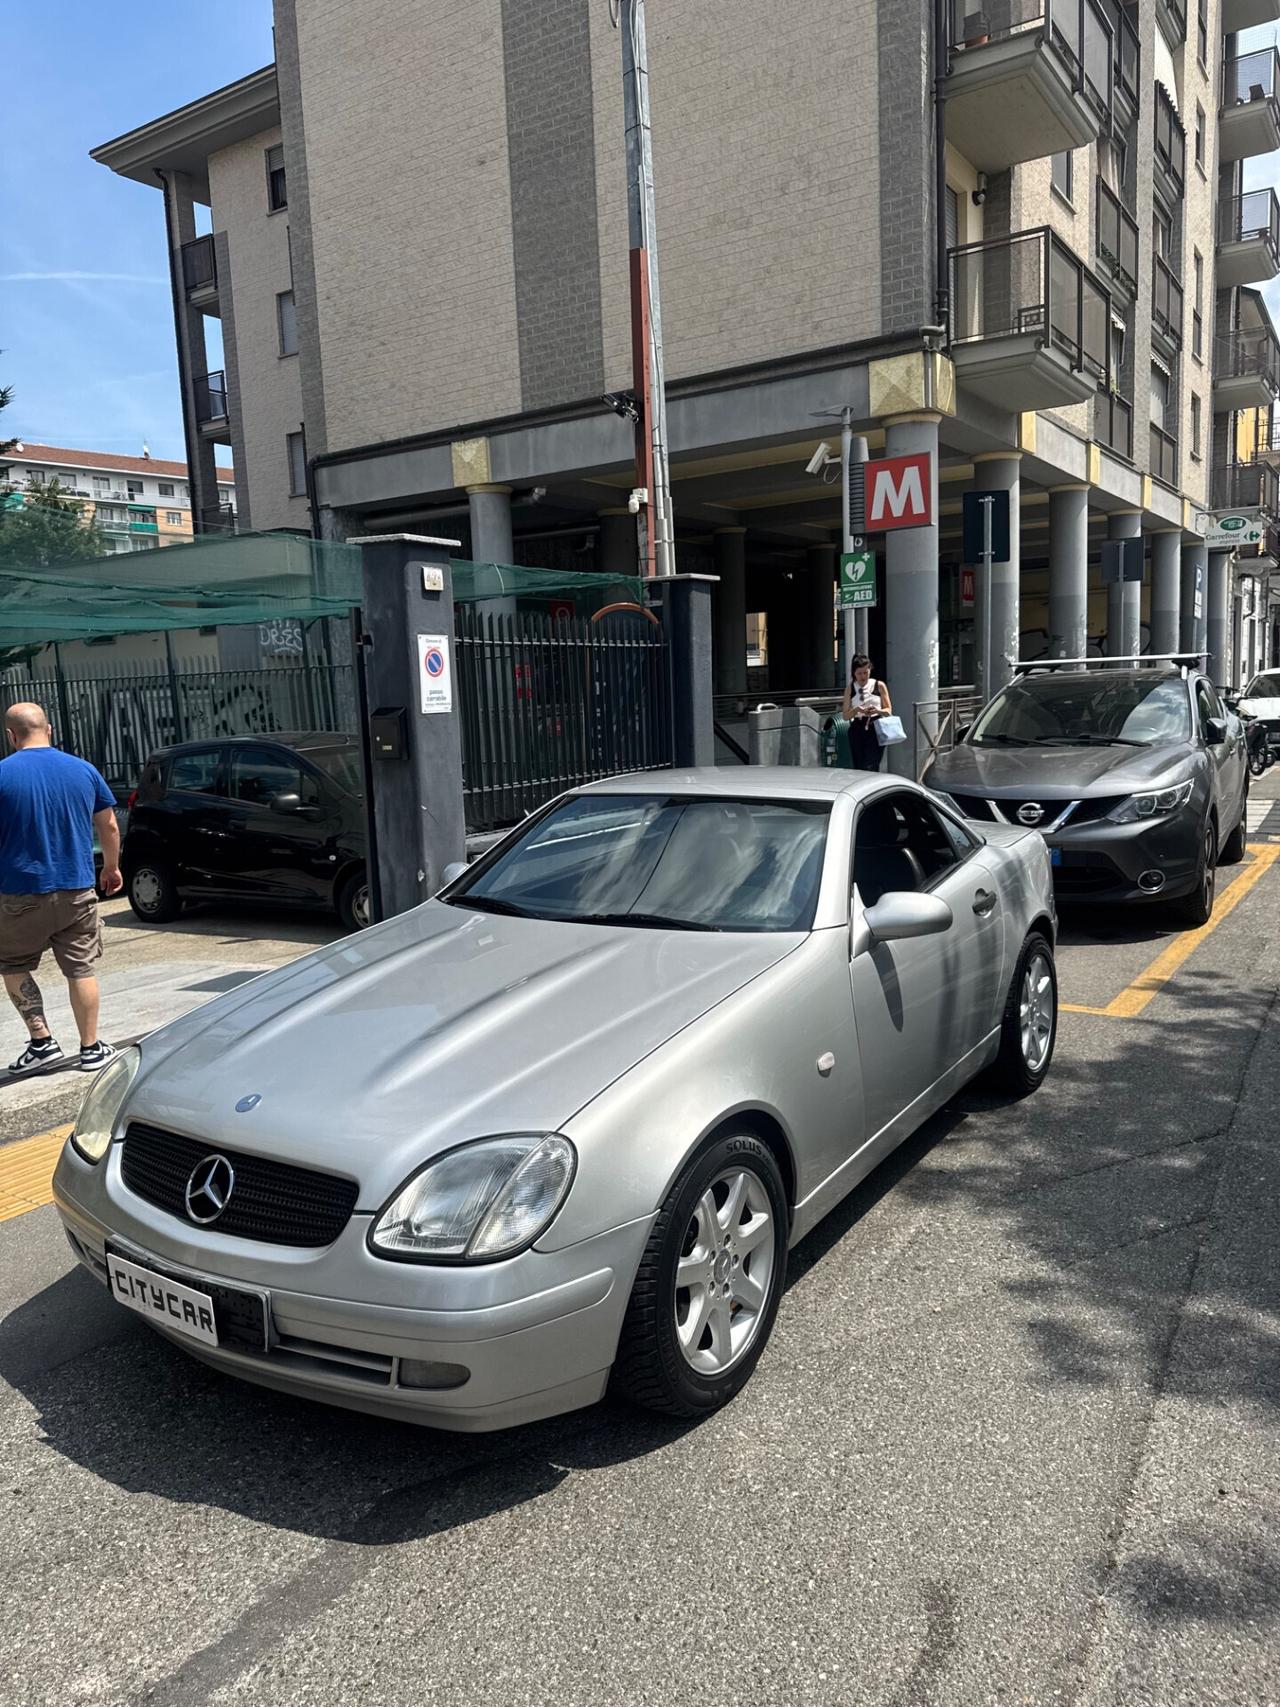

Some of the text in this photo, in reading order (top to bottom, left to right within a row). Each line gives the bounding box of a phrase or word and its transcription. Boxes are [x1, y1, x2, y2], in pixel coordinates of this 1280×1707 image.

[871, 466, 926, 520] M
[1205, 532, 1240, 541] Carrefour
[853, 590, 873, 601] AED
[726, 1140, 761, 1155] SOLUS
[115, 1270, 214, 1333] CITYCAR
